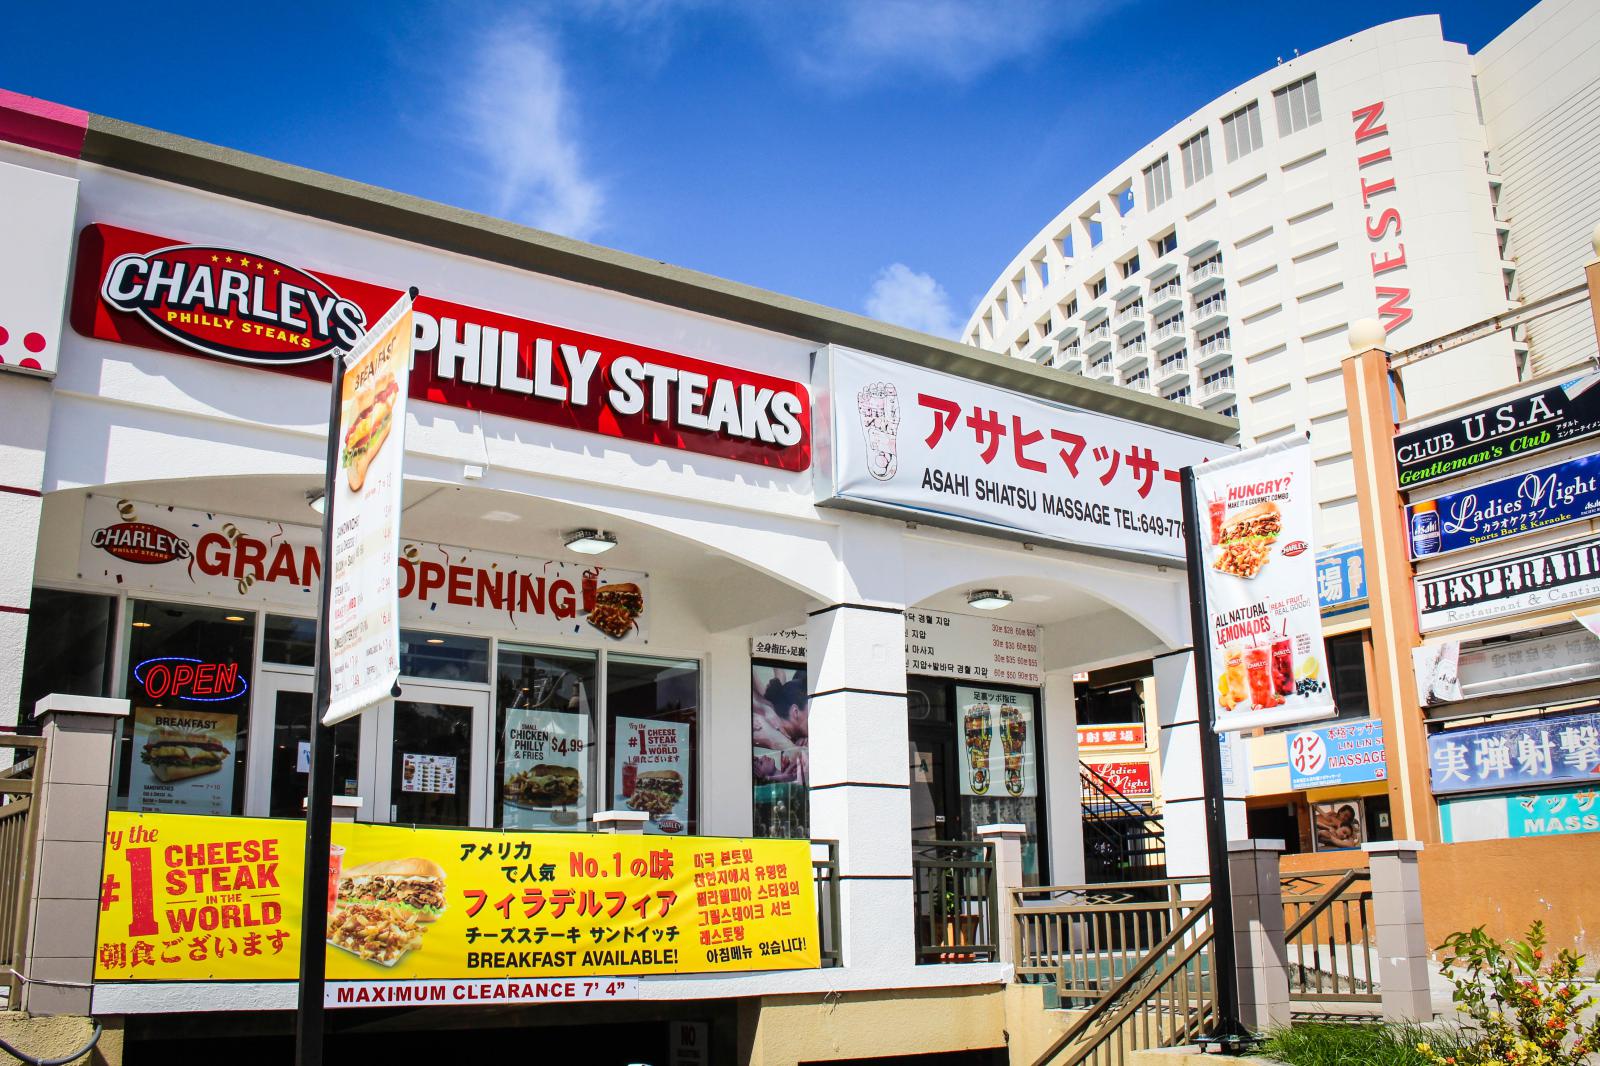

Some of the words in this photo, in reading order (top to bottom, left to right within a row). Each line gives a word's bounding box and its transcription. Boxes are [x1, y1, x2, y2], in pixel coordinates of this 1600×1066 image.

[1352, 101, 1413, 335] WESTIN
[108, 256, 366, 347] CHARLEYS
[167, 311, 233, 330] PHILLY
[242, 322, 312, 349] STEAKS
[410, 310, 602, 406] PHILLY
[608, 356, 803, 447] STEAKS
[1397, 432, 1455, 464] CLUB
[1462, 394, 1564, 443] U.S.A.
[917, 393, 1181, 499] アサヒマッサー
[1400, 446, 1503, 486] Gentleman's
[1509, 429, 1551, 454] Club
[921, 467, 969, 498] ASAHI
[975, 478, 1038, 510] SHIATSU
[1042, 492, 1111, 527] MASSAGE
[1228, 477, 1292, 501] HUNGRY?
[1228, 500, 1239, 509] MAKE
[1249, 495, 1271, 506] GOURMET
[1444, 494, 1522, 534] Ladies
[1518, 473, 1597, 509] Night
[1469, 531, 1499, 544] Sports
[1501, 527, 1518, 536] Bar
[1530, 513, 1572, 529] Karaoke
[1483, 507, 1547, 534] カラオケクラブ
[91, 528, 190, 559] CHARLEYS
[196, 532, 321, 587] GRAN
[398, 557, 577, 619] OPENING
[1285, 594, 1304, 606] FRUIT
[1448, 599, 1522, 622] Restaurant
[1528, 593, 1542, 606] &
[936, 616, 950, 627] 지압
[1216, 613, 1228, 628] ALL
[1228, 601, 1268, 623] NATURAL
[912, 629, 926, 640] 지압
[1216, 615, 1271, 645] LEMONADES
[756, 642, 807, 657] 全身指圧+足裏
[912, 644, 935, 656] 마사지
[145, 663, 238, 698] OPEN
[974, 666, 988, 678] 지압
[155, 716, 218, 730] BREAKFAST
[521, 723, 538, 731] SMALL
[648, 728, 677, 737] CHEESE
[510, 729, 549, 742] CHICKEN
[515, 740, 545, 752] PHILLY
[551, 736, 584, 756] $4.99
[648, 736, 677, 744] STEAK
[1338, 741, 1354, 750] LIN
[1356, 738, 1373, 748] LIN
[514, 751, 521, 759] &
[522, 751, 544, 761] FRIES
[649, 747, 678, 755] WORLD
[1329, 750, 1387, 769] MASSAGE
[1434, 727, 1600, 784] 実弾射撃
[1095, 762, 1137, 779] Ladies
[1107, 774, 1149, 790] Night
[128, 824, 159, 844] the
[164, 838, 279, 868] CHEESE
[460, 841, 532, 862] アメリカ
[694, 852, 715, 868] 미국
[165, 862, 280, 896] STEAK
[501, 863, 557, 883] で人気
[755, 864, 787, 881] 유명한
[206, 895, 218, 904] IN
[220, 893, 242, 904] THE
[463, 888, 678, 919] フィラデルフィア
[697, 886, 752, 907] 필라델피아
[758, 881, 800, 899] 스타일의
[165, 901, 282, 934] WORLD
[698, 904, 765, 926] 그릴스테이크
[770, 900, 792, 916] 서브
[466, 926, 582, 944] チーズステーキ
[590, 926, 680, 944] サンドイッチ
[700, 925, 745, 945] 레스토랑
[100, 929, 291, 970] 朝食ございます
[467, 951, 577, 969] BREAKFAST
[581, 949, 678, 968] AVAILABLE!
[706, 945, 753, 963] 아침메뉴
[758, 937, 807, 956] 있습니다!
[337, 986, 446, 1003] MAXIMUM
[452, 982, 576, 1000] CLEARANCE
